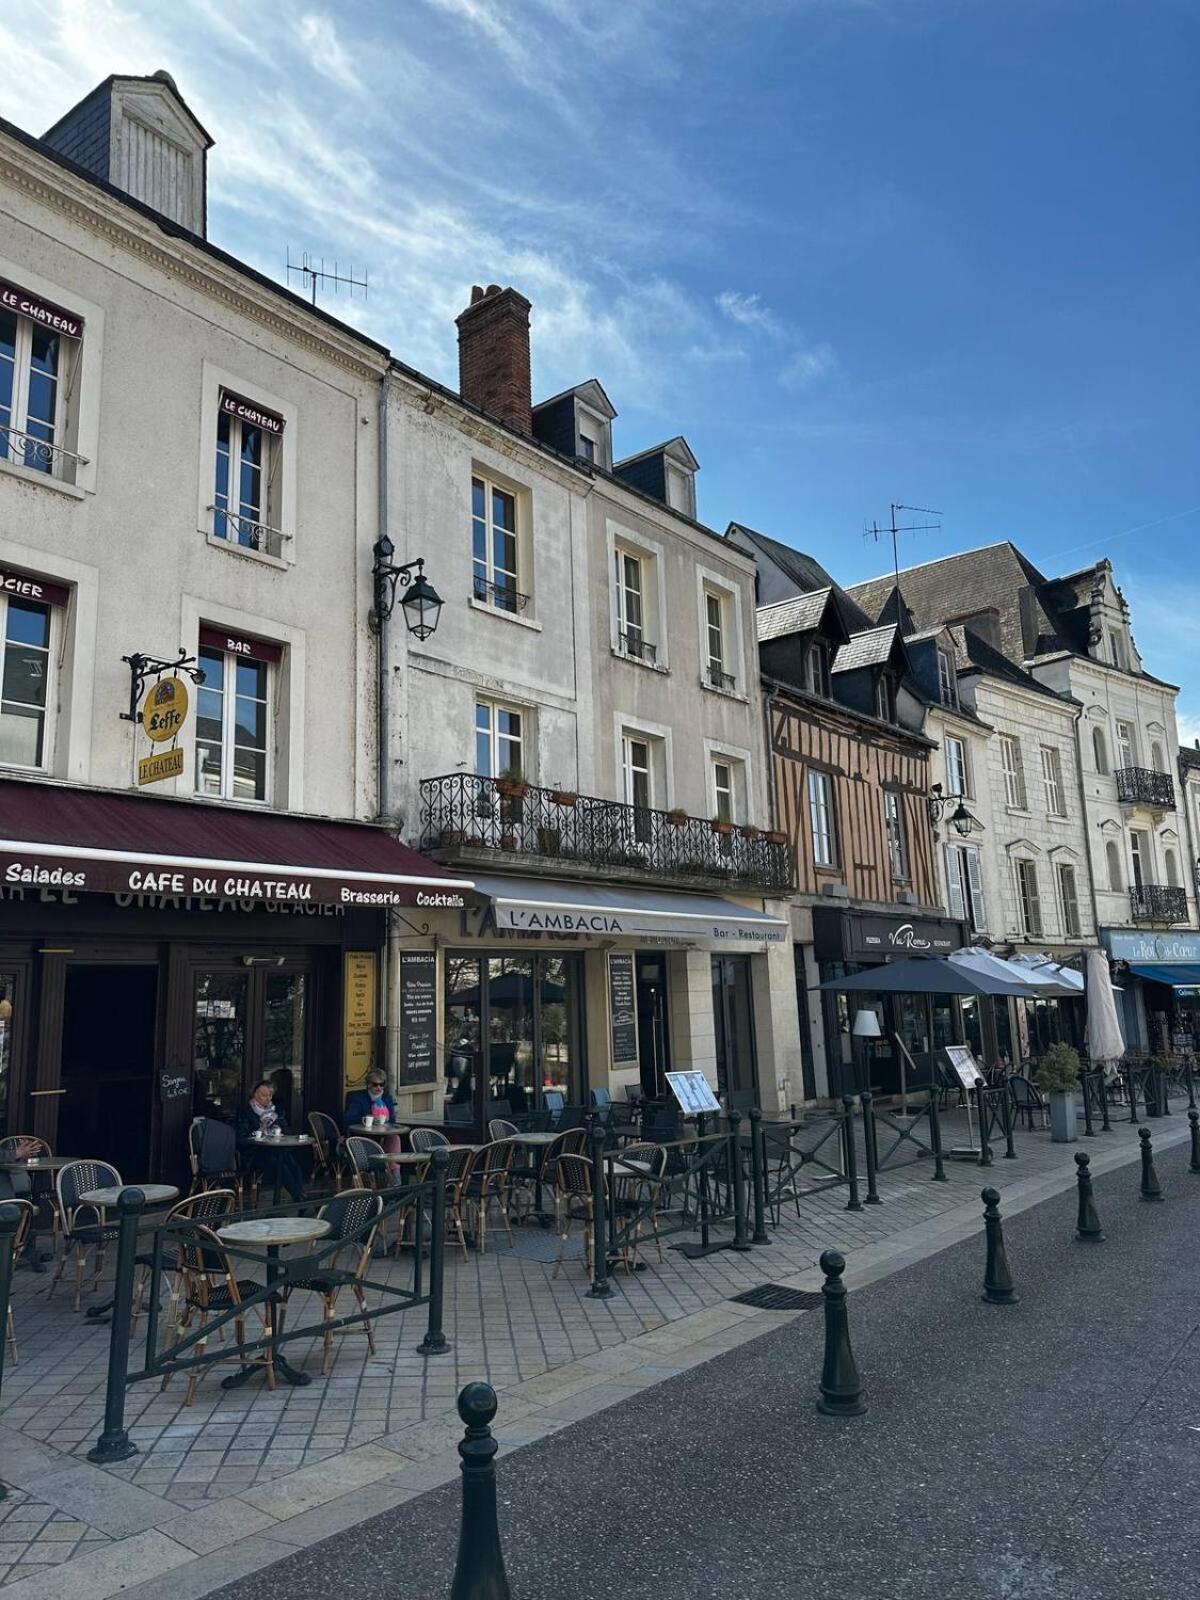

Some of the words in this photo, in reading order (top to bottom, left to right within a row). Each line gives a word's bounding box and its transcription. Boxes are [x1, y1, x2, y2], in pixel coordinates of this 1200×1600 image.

[2, 291, 18, 306] LE
[20, 301, 77, 335] CHATEAU
[224, 399, 236, 411] LE
[238, 405, 280, 431] CHATEAU
[227, 638, 251, 654] BAR
[150, 707, 181, 731] Leffe
[5, 863, 86, 886] Salades
[128, 871, 185, 892] CAFE
[192, 877, 217, 894] DU
[223, 878, 312, 900] CHATEAU
[340, 887, 400, 905] Brasserie
[416, 891, 465, 907] Cocktails
[509, 910, 623, 933] L'AMBACIA
[713, 927, 729, 938] Bar
[738, 929, 780, 940] Restaurant
